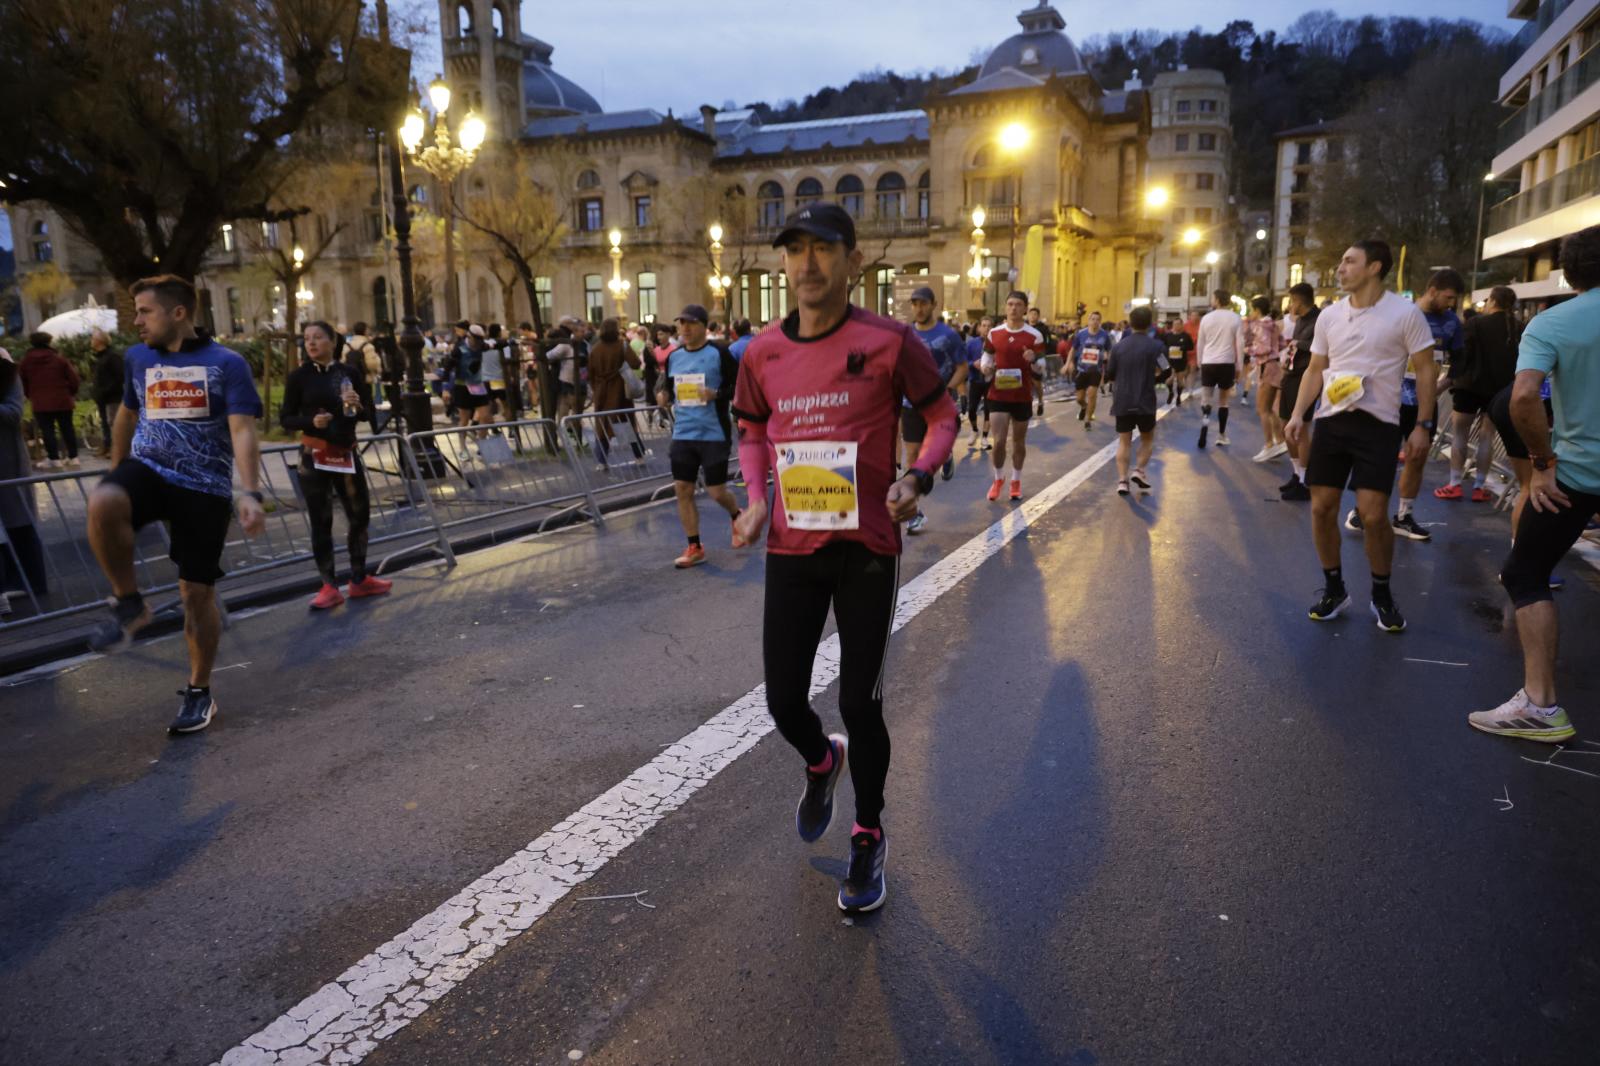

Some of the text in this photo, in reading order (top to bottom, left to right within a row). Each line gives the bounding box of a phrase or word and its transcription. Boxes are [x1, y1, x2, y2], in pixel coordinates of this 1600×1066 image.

[154, 389, 204, 398] GONZALO
[778, 391, 849, 414] telepizza
[799, 449, 840, 461] ZURICH
[787, 486, 853, 495] MIGUEL ANGEL
